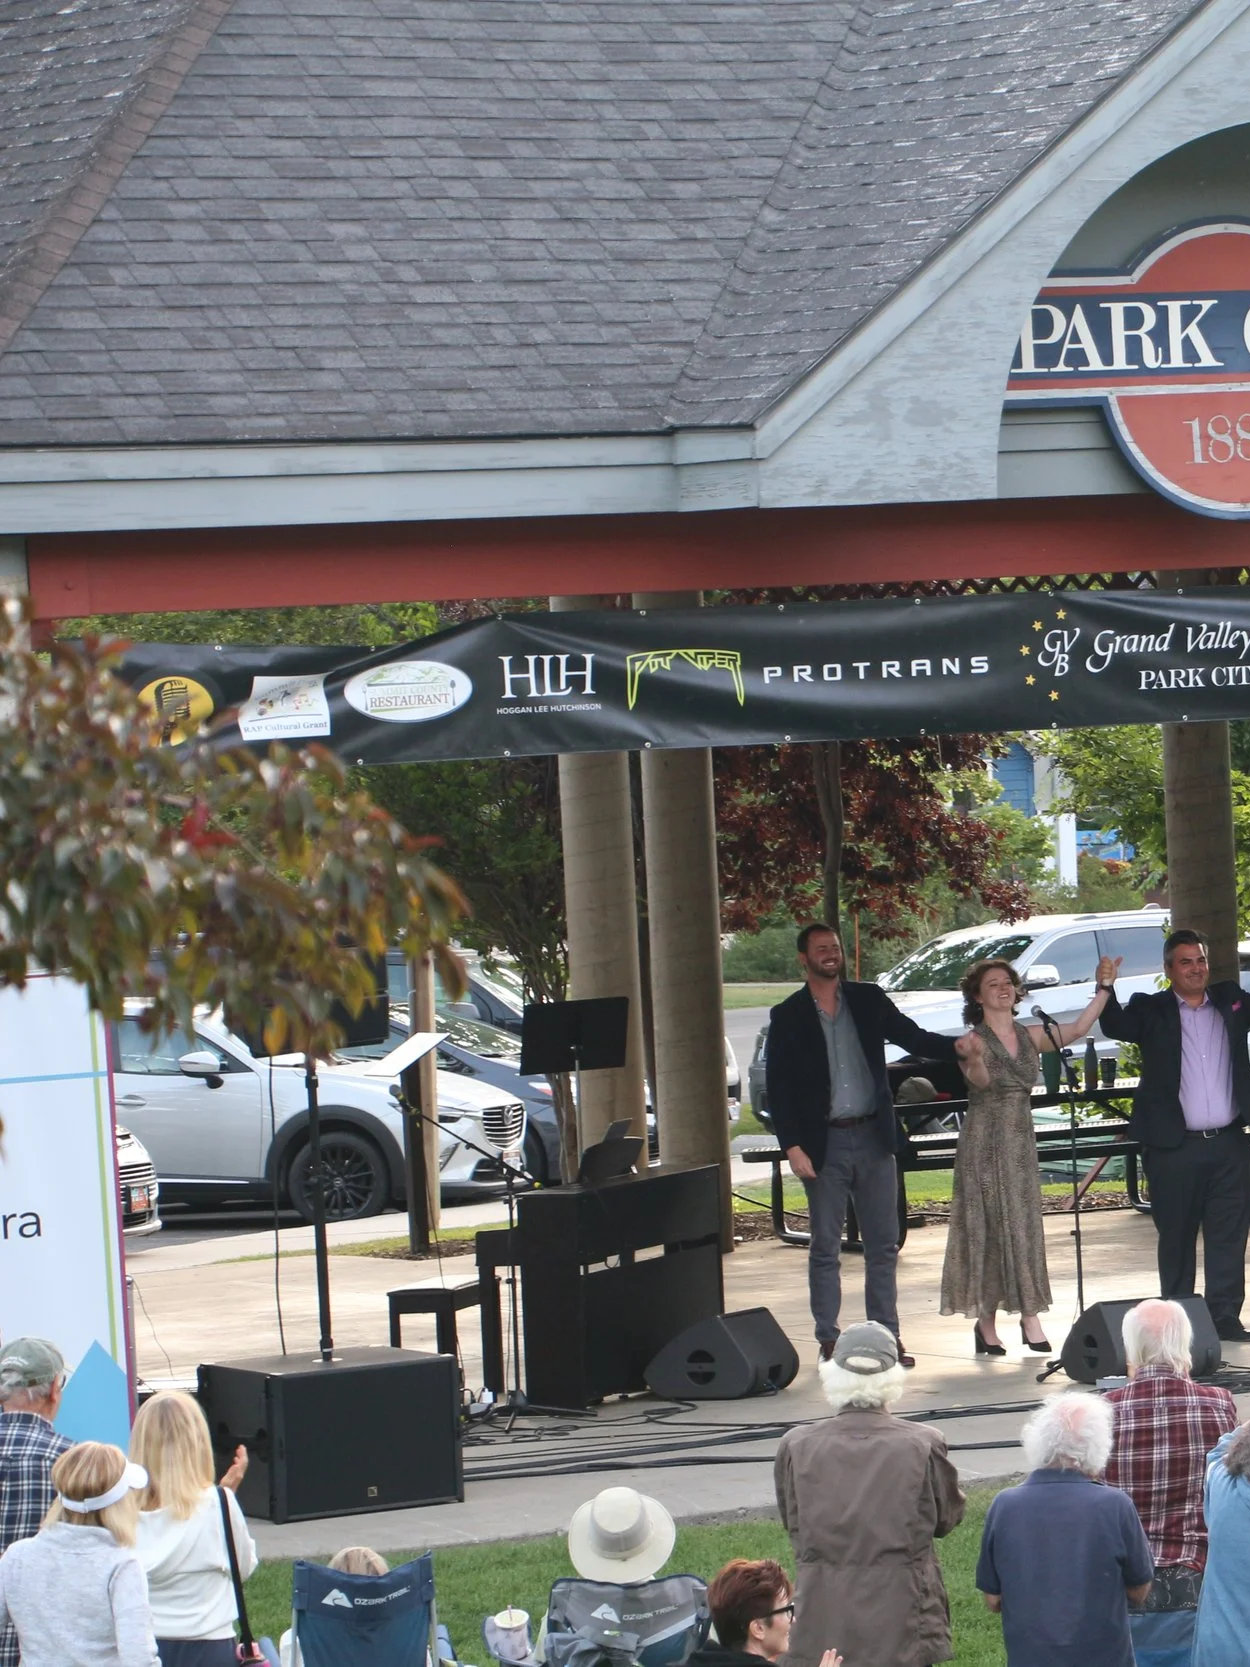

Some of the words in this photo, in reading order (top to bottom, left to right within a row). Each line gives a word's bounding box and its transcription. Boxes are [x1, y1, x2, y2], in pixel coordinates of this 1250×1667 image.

[1011, 300, 1224, 374] PARK
[1085, 622, 1176, 673] Grand
[498, 653, 596, 699] HLH
[762, 655, 989, 685] PROTRANS
[1138, 668, 1206, 690] PARK
[369, 693, 450, 708] RESTAURANT
[496, 706, 533, 715] HOGGAN
[534, 705, 548, 713] LEE
[550, 703, 602, 712] HUTCHINSON
[264, 722, 301, 732] Cultural
[302, 720, 327, 729] Grant
